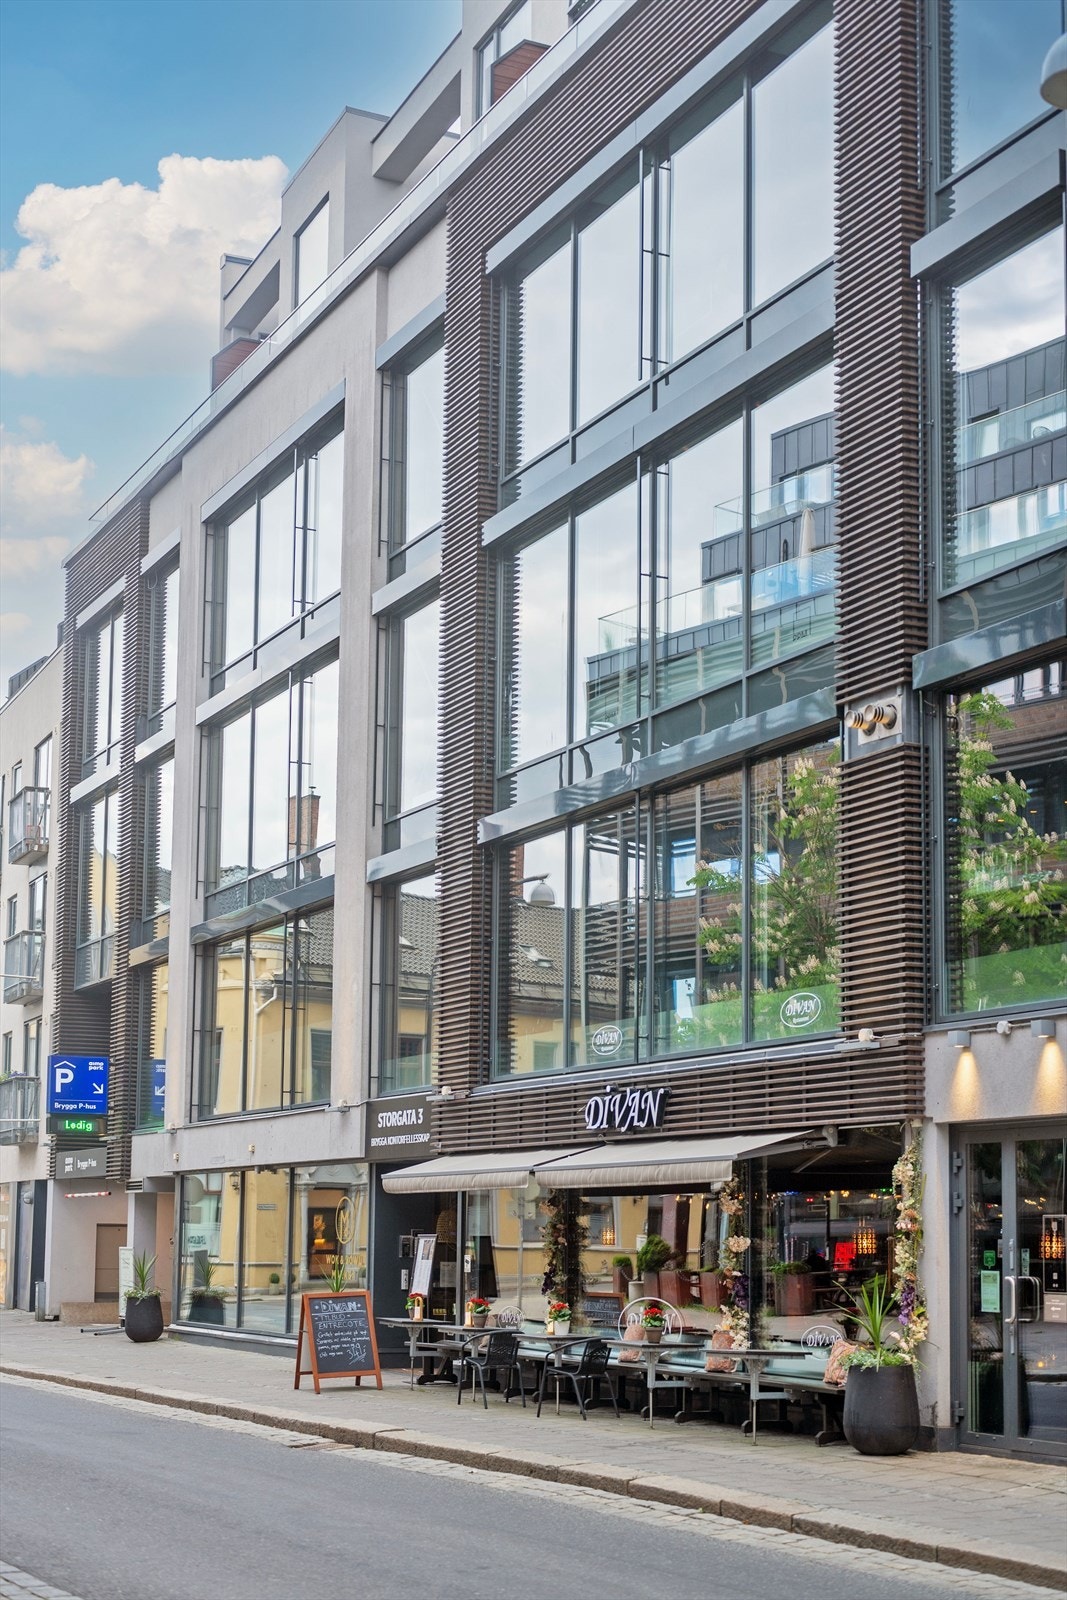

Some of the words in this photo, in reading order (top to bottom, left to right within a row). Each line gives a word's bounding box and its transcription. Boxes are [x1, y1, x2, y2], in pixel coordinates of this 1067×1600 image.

[55, 1068, 74, 1093] P
[54, 1102, 77, 1110] Brygga
[377, 1109, 417, 1128] STORGATA
[417, 1107, 424, 1124] 3
[65, 1120, 93, 1132] Ledig
[370, 1136, 388, 1147] BRYGGA
[318, 1320, 363, 1330] ENTRECOTE
